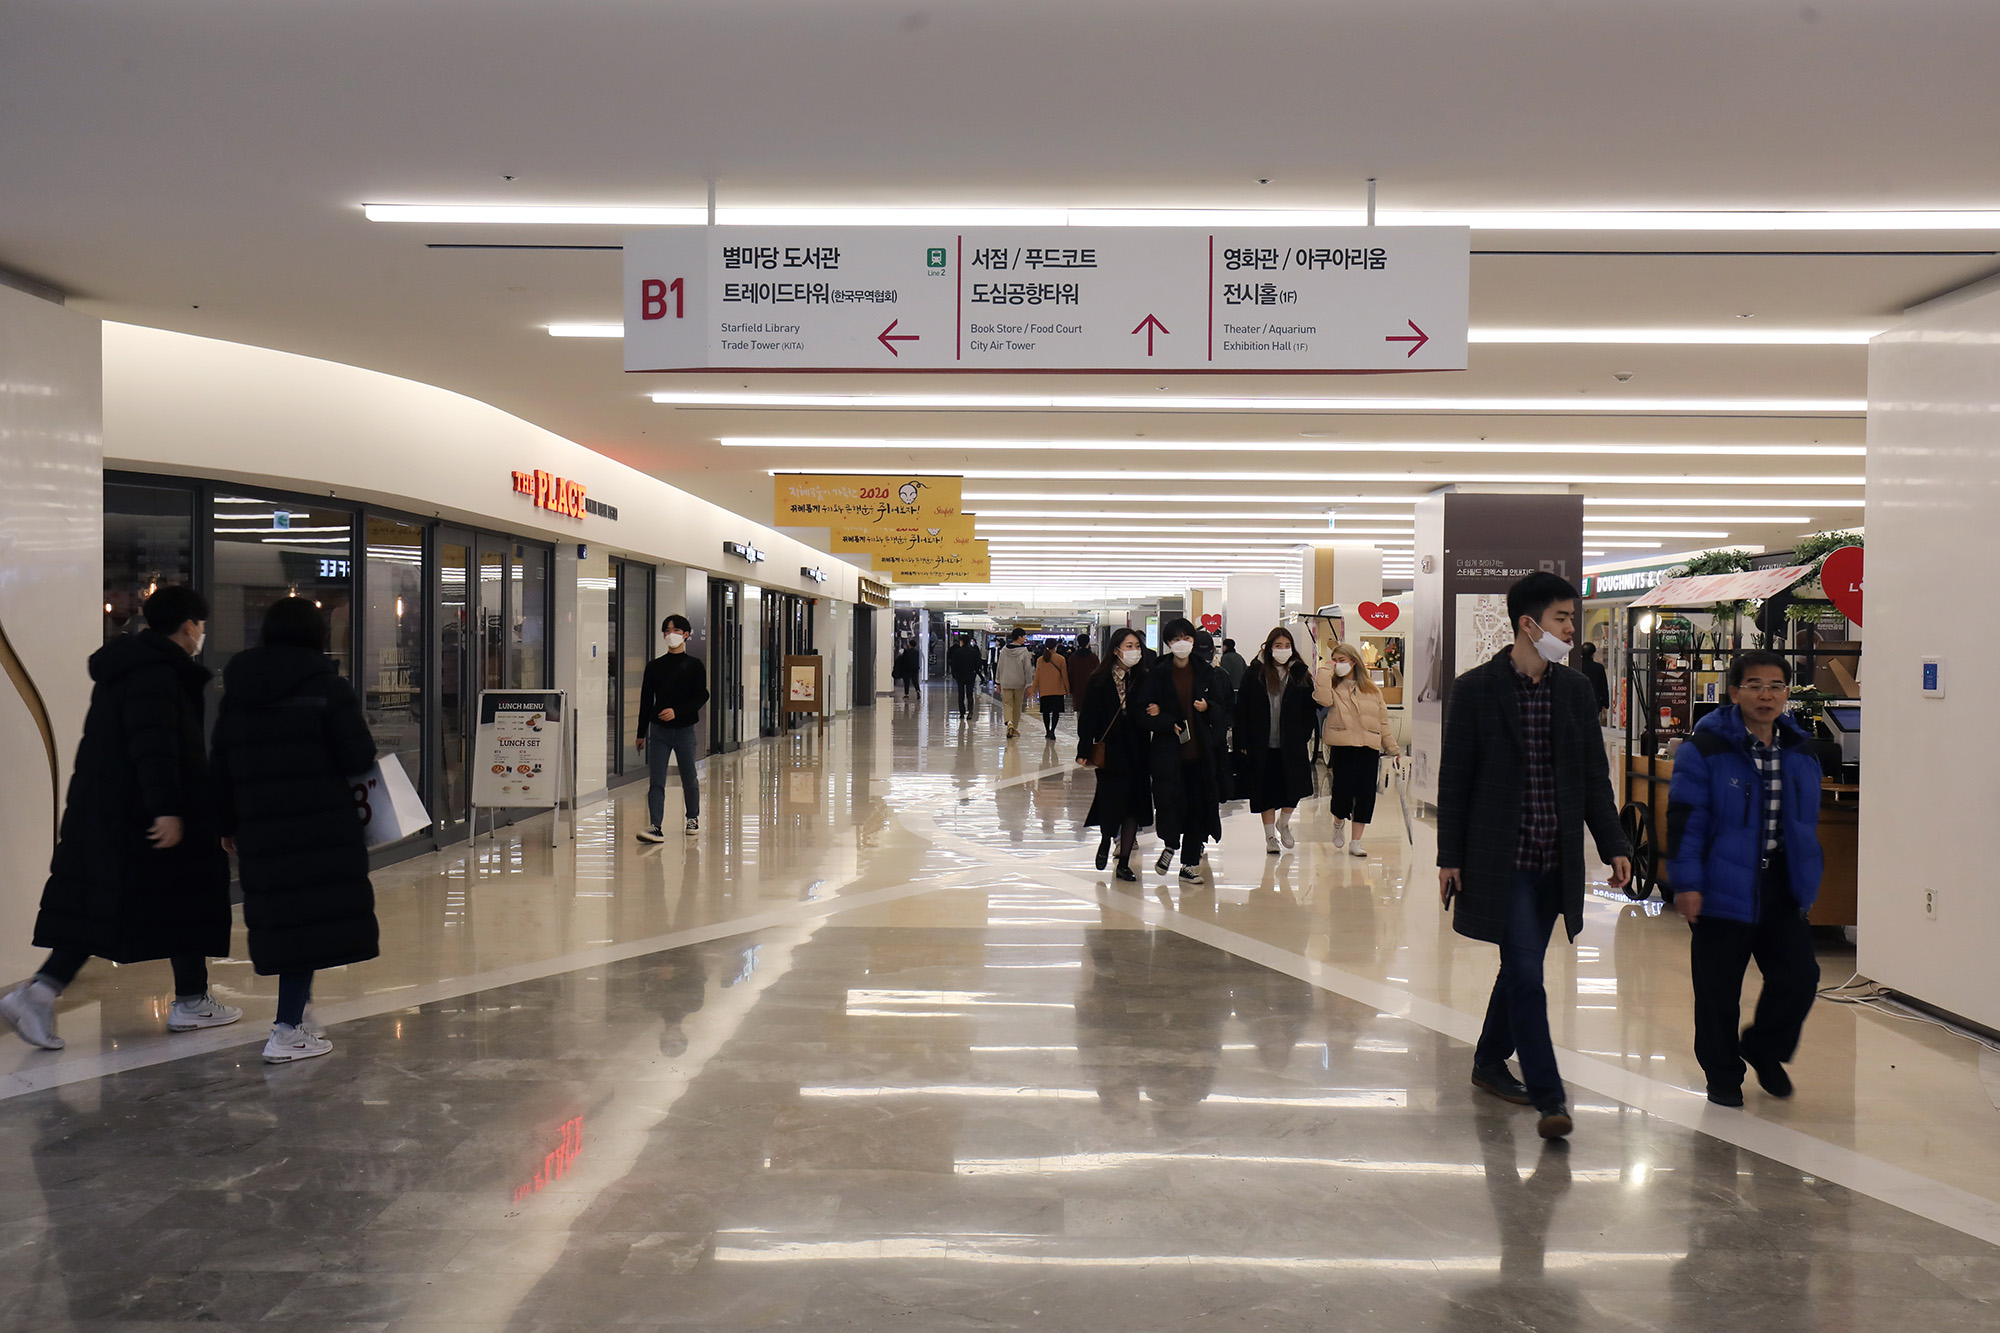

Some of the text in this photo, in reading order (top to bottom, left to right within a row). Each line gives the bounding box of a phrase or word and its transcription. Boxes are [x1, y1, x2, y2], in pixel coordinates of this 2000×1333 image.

[723, 246, 841, 270] 별마당 도서관
[971, 248, 1008, 271] 서점
[1025, 247, 1098, 270] 푸드코트
[1223, 247, 1280, 271] 영화관
[1295, 247, 1388, 271] 아쿠아리움
[641, 277, 684, 320] B1
[970, 282, 1080, 306] 도심공항타워
[721, 322, 801, 337] Starfield Library
[970, 323, 995, 335] Book
[997, 323, 1022, 335] Store
[1031, 323, 1054, 335] Food
[1056, 323, 1083, 335] Court
[1223, 323, 1262, 335] Theater
[1269, 323, 1317, 337] Aquarium
[721, 340, 749, 351] Trade
[970, 340, 1036, 353] City Air Tower
[1223, 340, 1270, 351] Exhibition
[511, 470, 535, 496] THE
[533, 469, 587, 520] PLACE
[860, 487, 890, 499] 2020
[1456, 568, 1482, 576] 스타필드
[1483, 568, 1509, 576] 코엑스몰
[1596, 571, 1645, 593] DOUGHNUTS
[1647, 571, 1655, 587] &
